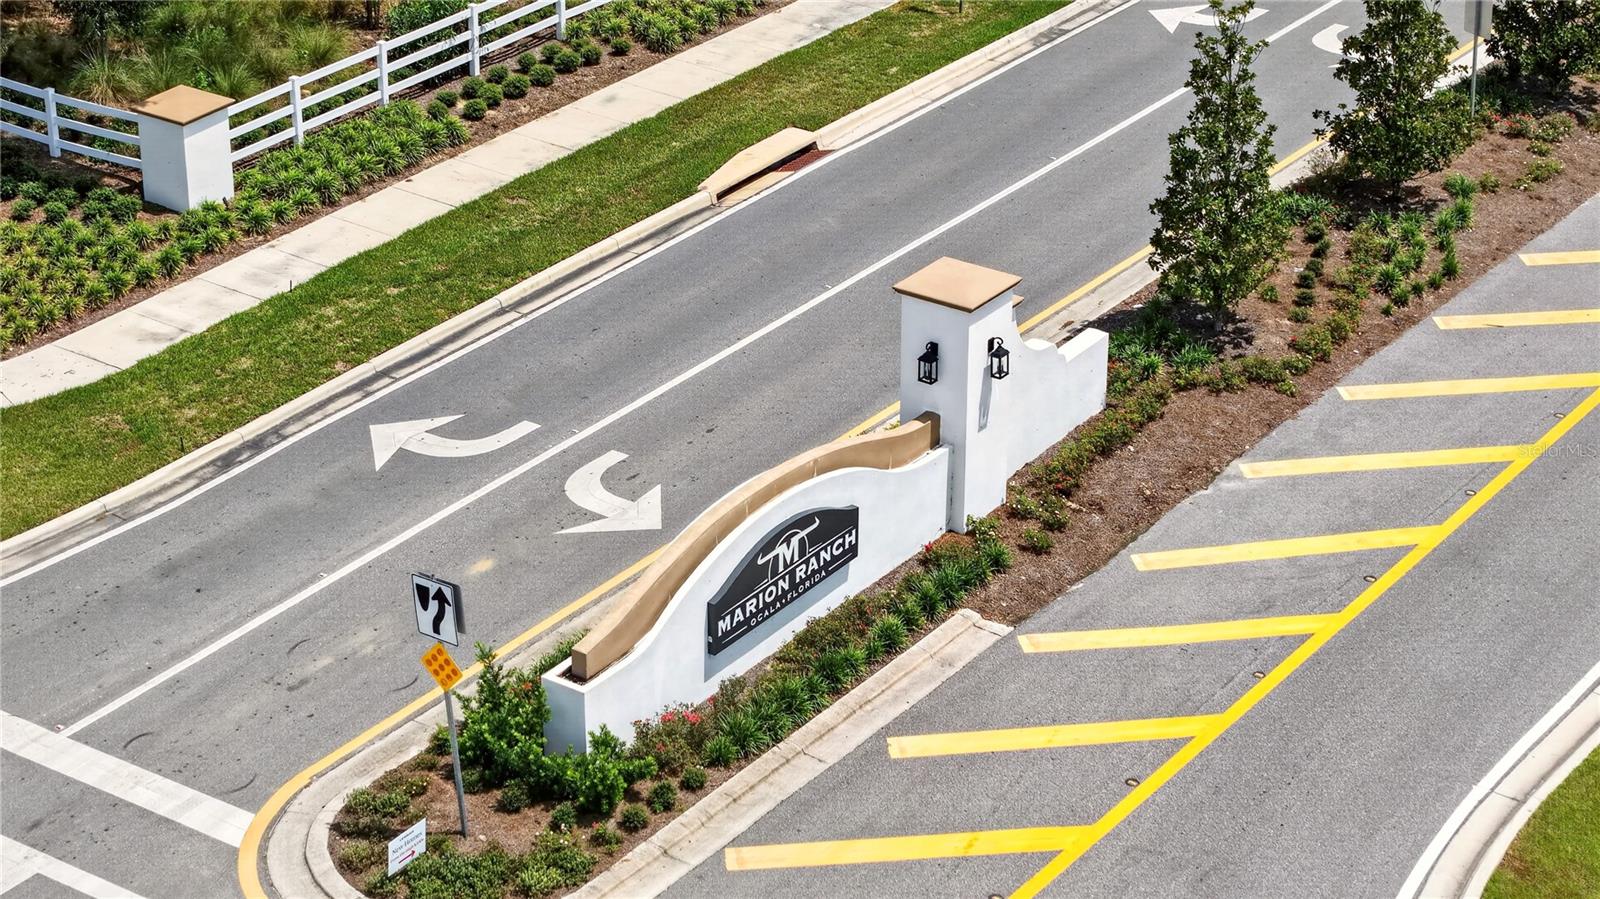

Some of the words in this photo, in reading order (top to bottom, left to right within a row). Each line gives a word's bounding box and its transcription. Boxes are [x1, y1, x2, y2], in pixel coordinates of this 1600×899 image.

[717, 574, 790, 637] MARION
[795, 528, 856, 583] RANCH
[750, 603, 781, 626] OCALA
[787, 570, 826, 602] FLORIDA
